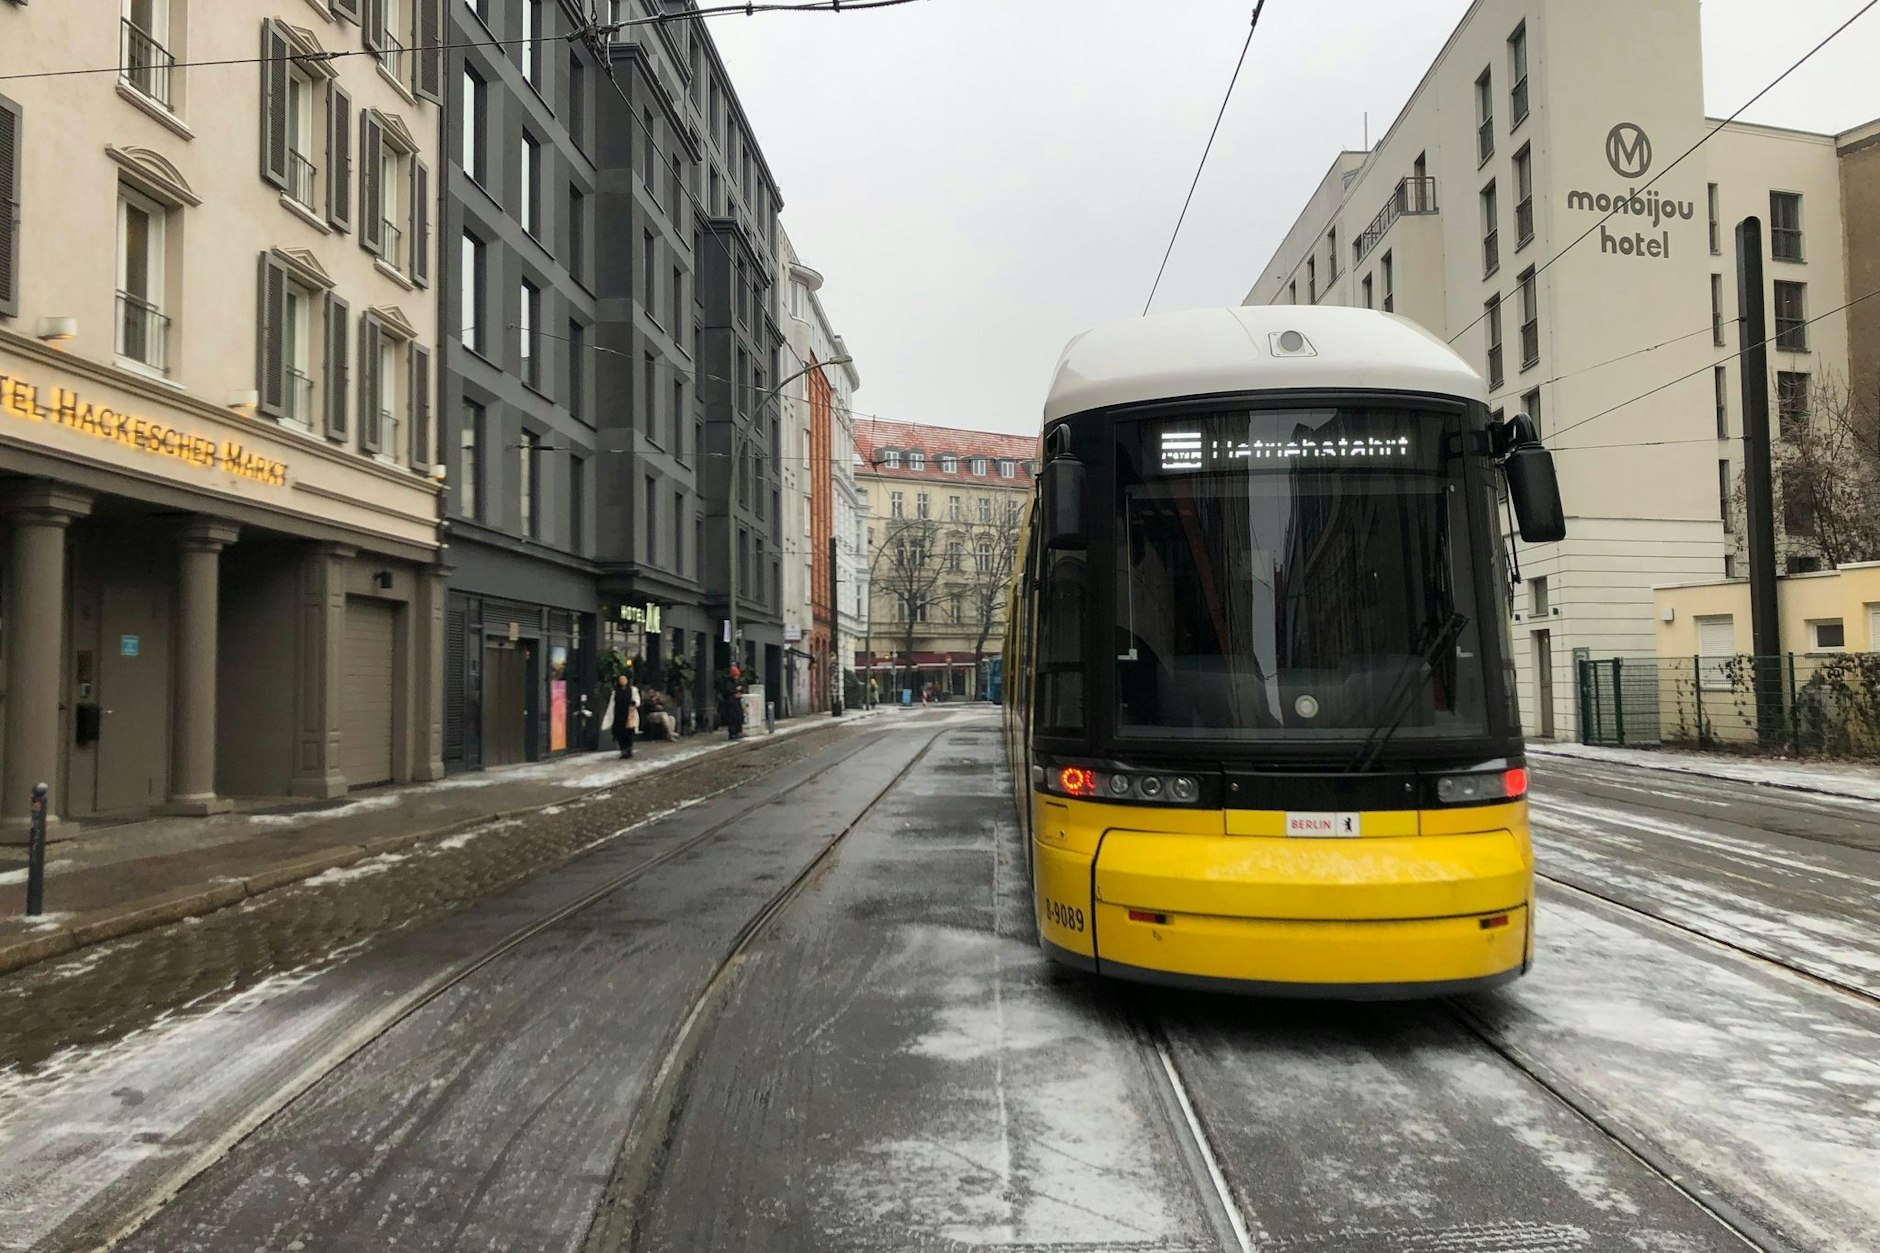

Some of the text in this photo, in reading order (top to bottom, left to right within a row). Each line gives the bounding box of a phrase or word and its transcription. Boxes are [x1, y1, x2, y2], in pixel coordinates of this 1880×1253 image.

[1567, 187, 1694, 228] monbijou
[1600, 224, 1669, 258] hotel
[620, 605, 646, 623] HOTEL
[1291, 819, 1331, 830] BERLIN
